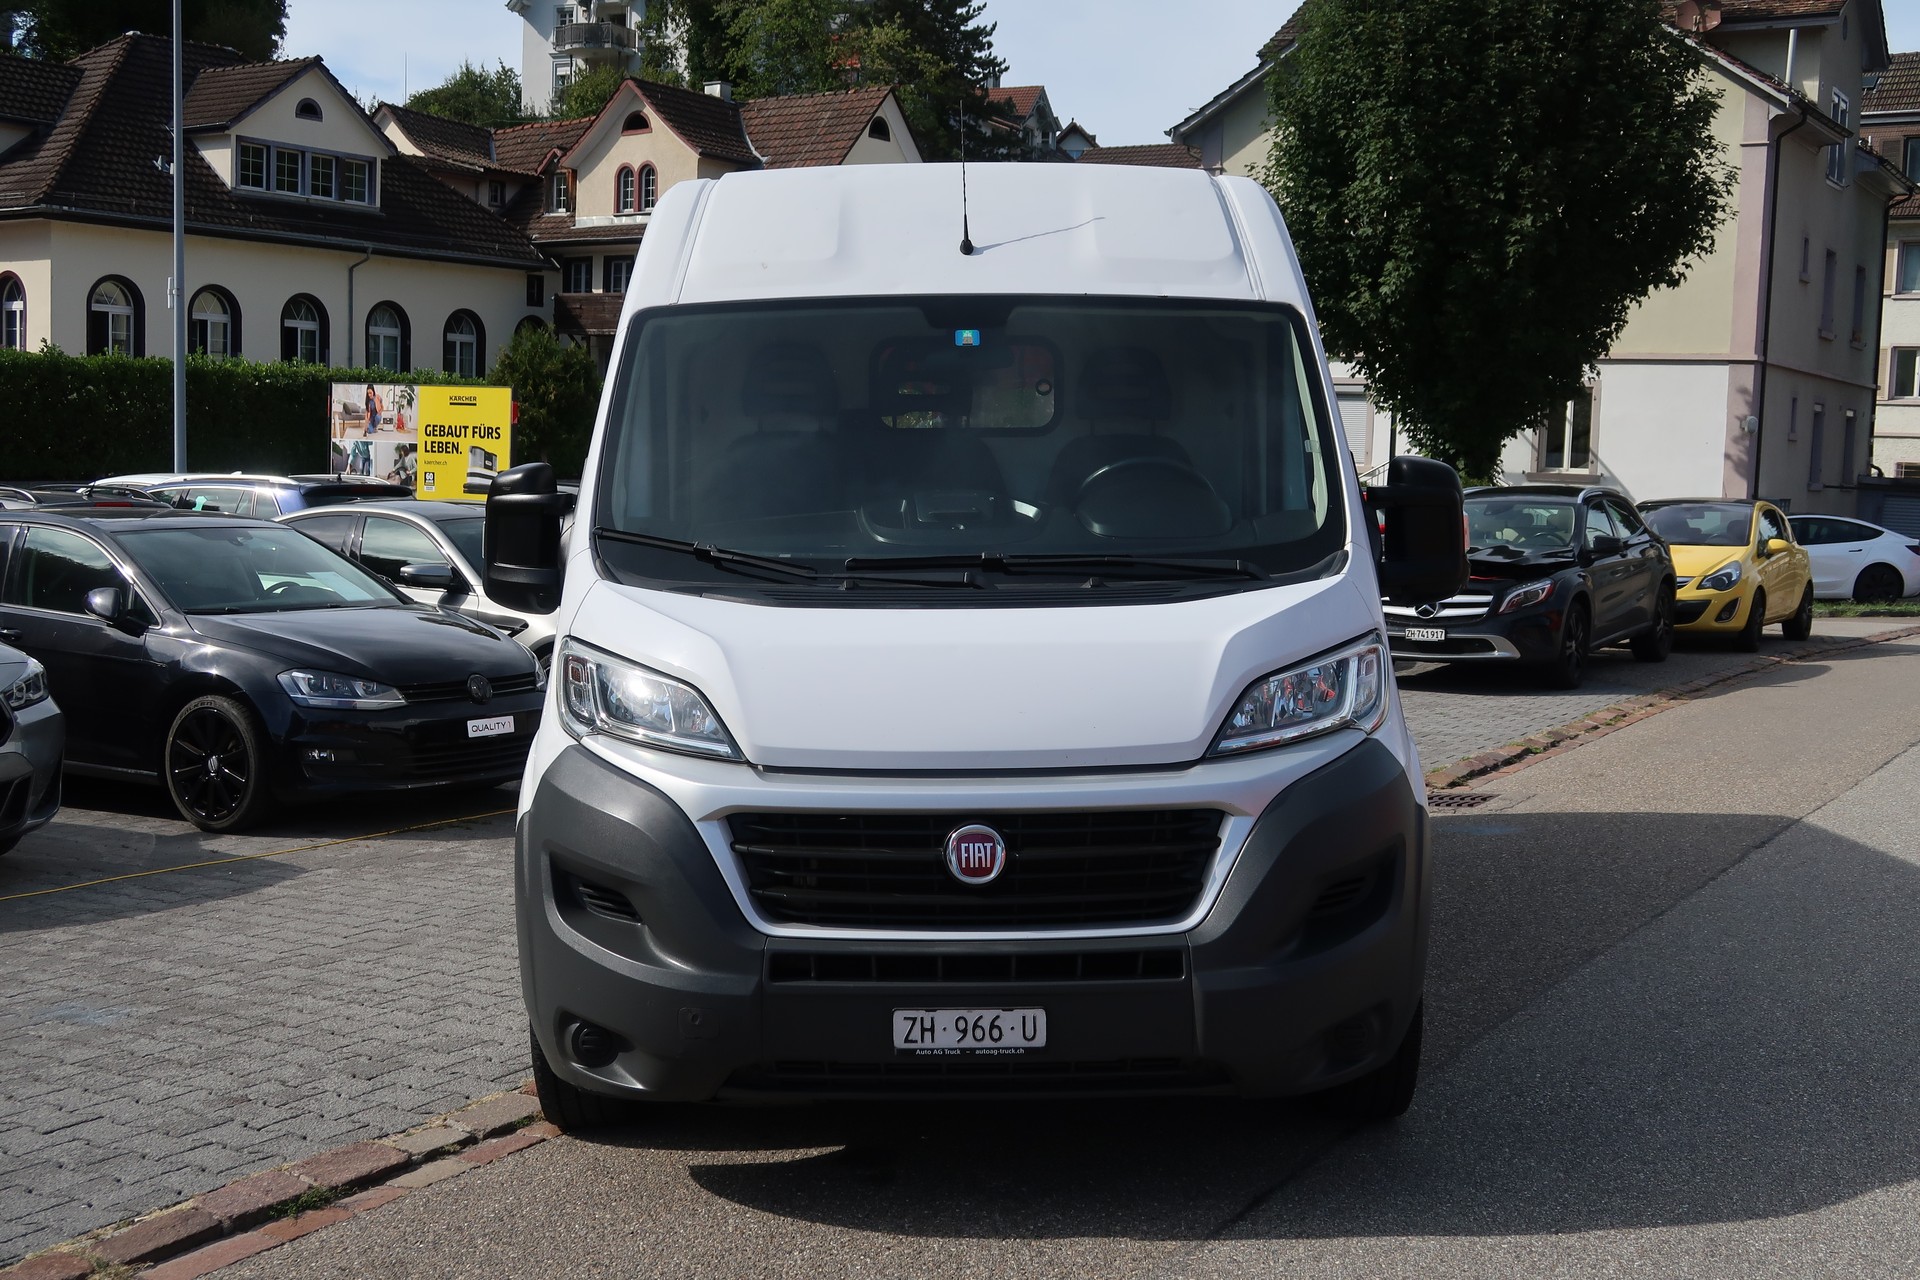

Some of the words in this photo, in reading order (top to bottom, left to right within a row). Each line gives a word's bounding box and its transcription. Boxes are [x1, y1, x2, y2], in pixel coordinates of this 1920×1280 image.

[424, 424, 469, 438] GEBAUT
[472, 423, 501, 440] FÜRS
[424, 440, 463, 455] LEBEN.
[471, 722, 507, 733] QUALITY
[961, 843, 993, 868] FIAT
